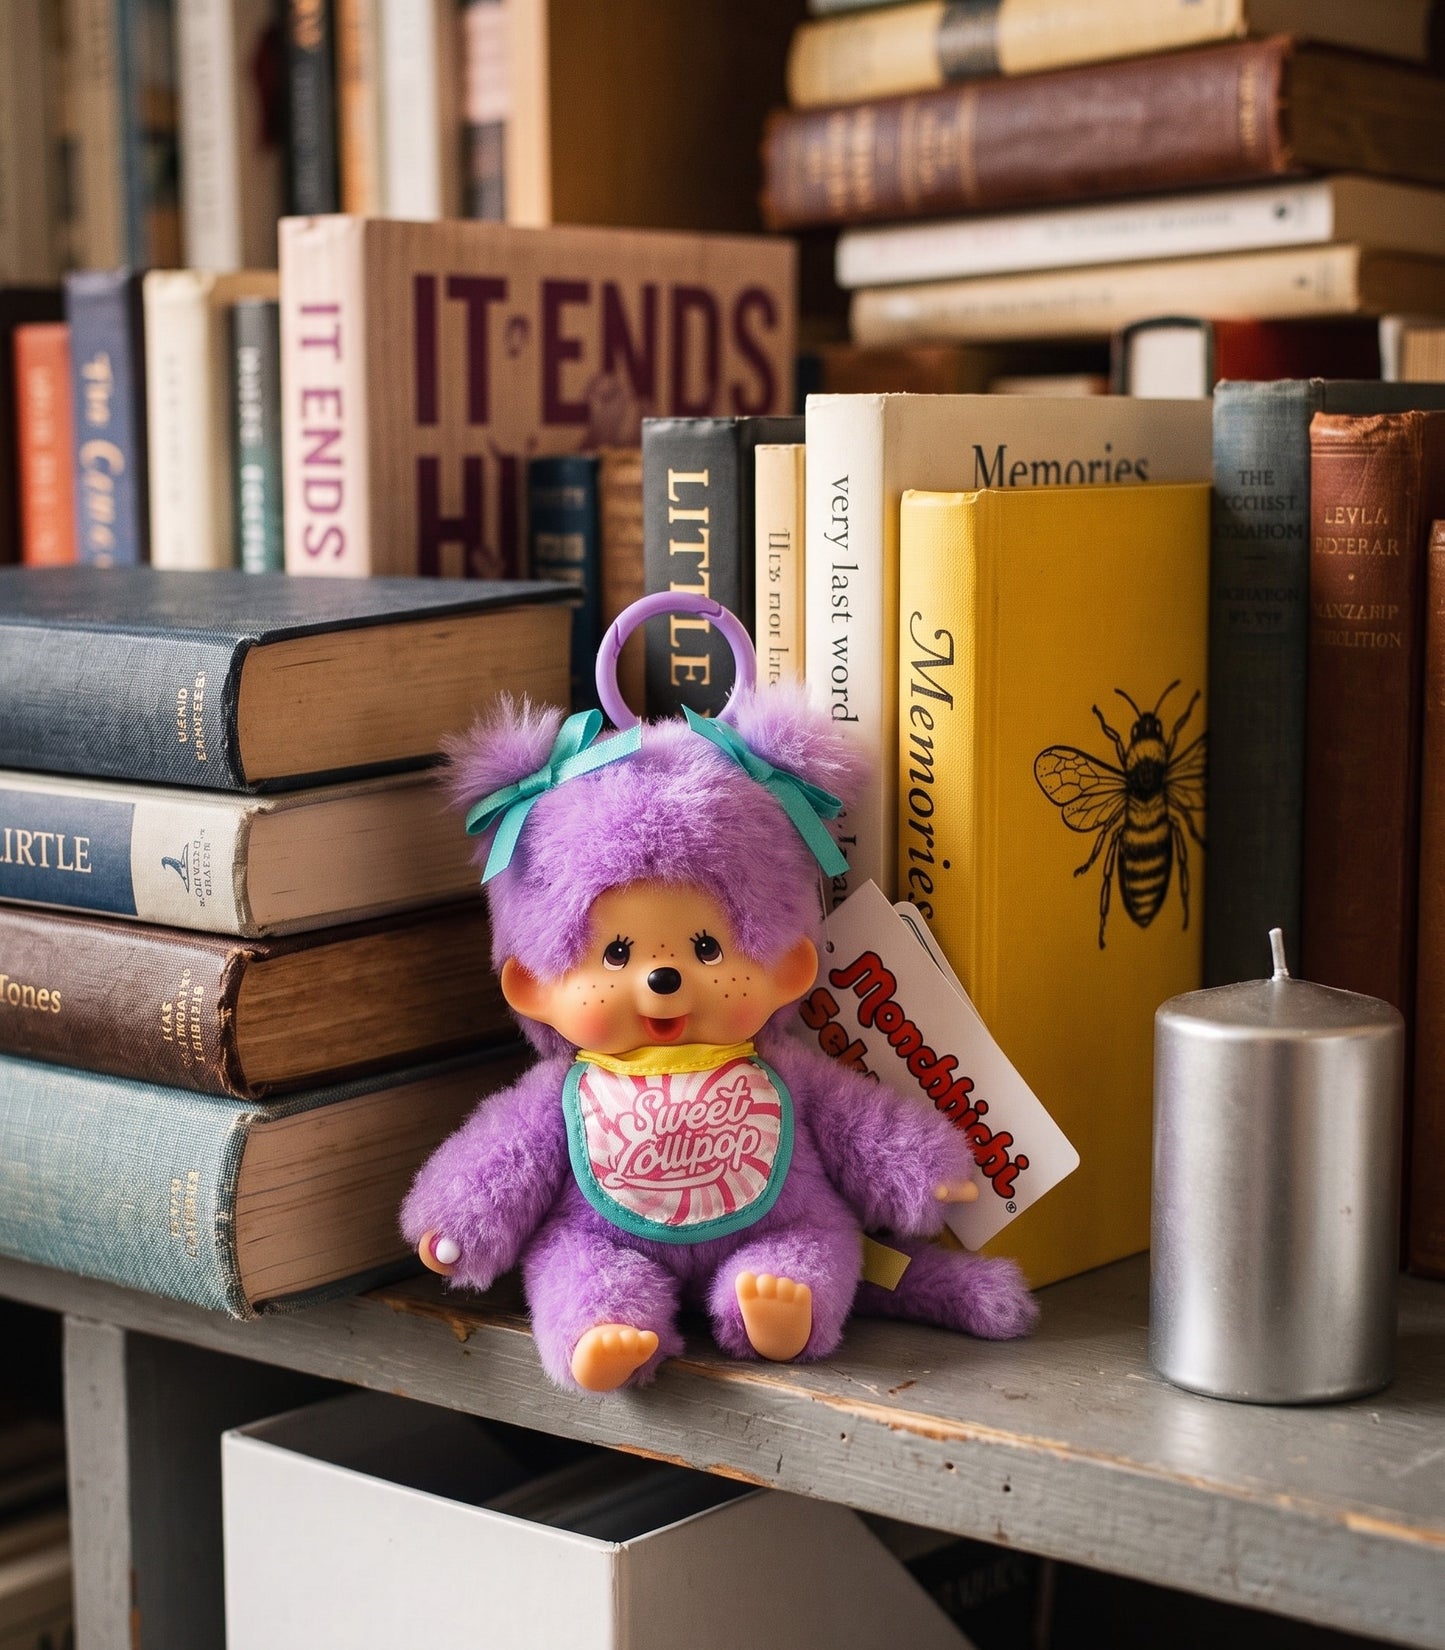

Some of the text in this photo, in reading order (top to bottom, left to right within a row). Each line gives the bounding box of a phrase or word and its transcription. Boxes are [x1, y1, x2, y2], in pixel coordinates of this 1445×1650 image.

[414, 273, 508, 427] IT
[541, 279, 780, 427] ENDS
[299, 303, 347, 560] IT ENDS
[971, 442, 1151, 488] Memories
[1238, 469, 1275, 486] THE
[667, 468, 711, 687] LITTLE
[824, 474, 860, 724] very last word
[908, 610, 955, 920] Memories
[0, 827, 92, 874] IRTLE
[618, 1075, 754, 1145] Sweet
[828, 950, 1031, 1200] Monchhichi
[602, 1125, 762, 1192] Lollipop
